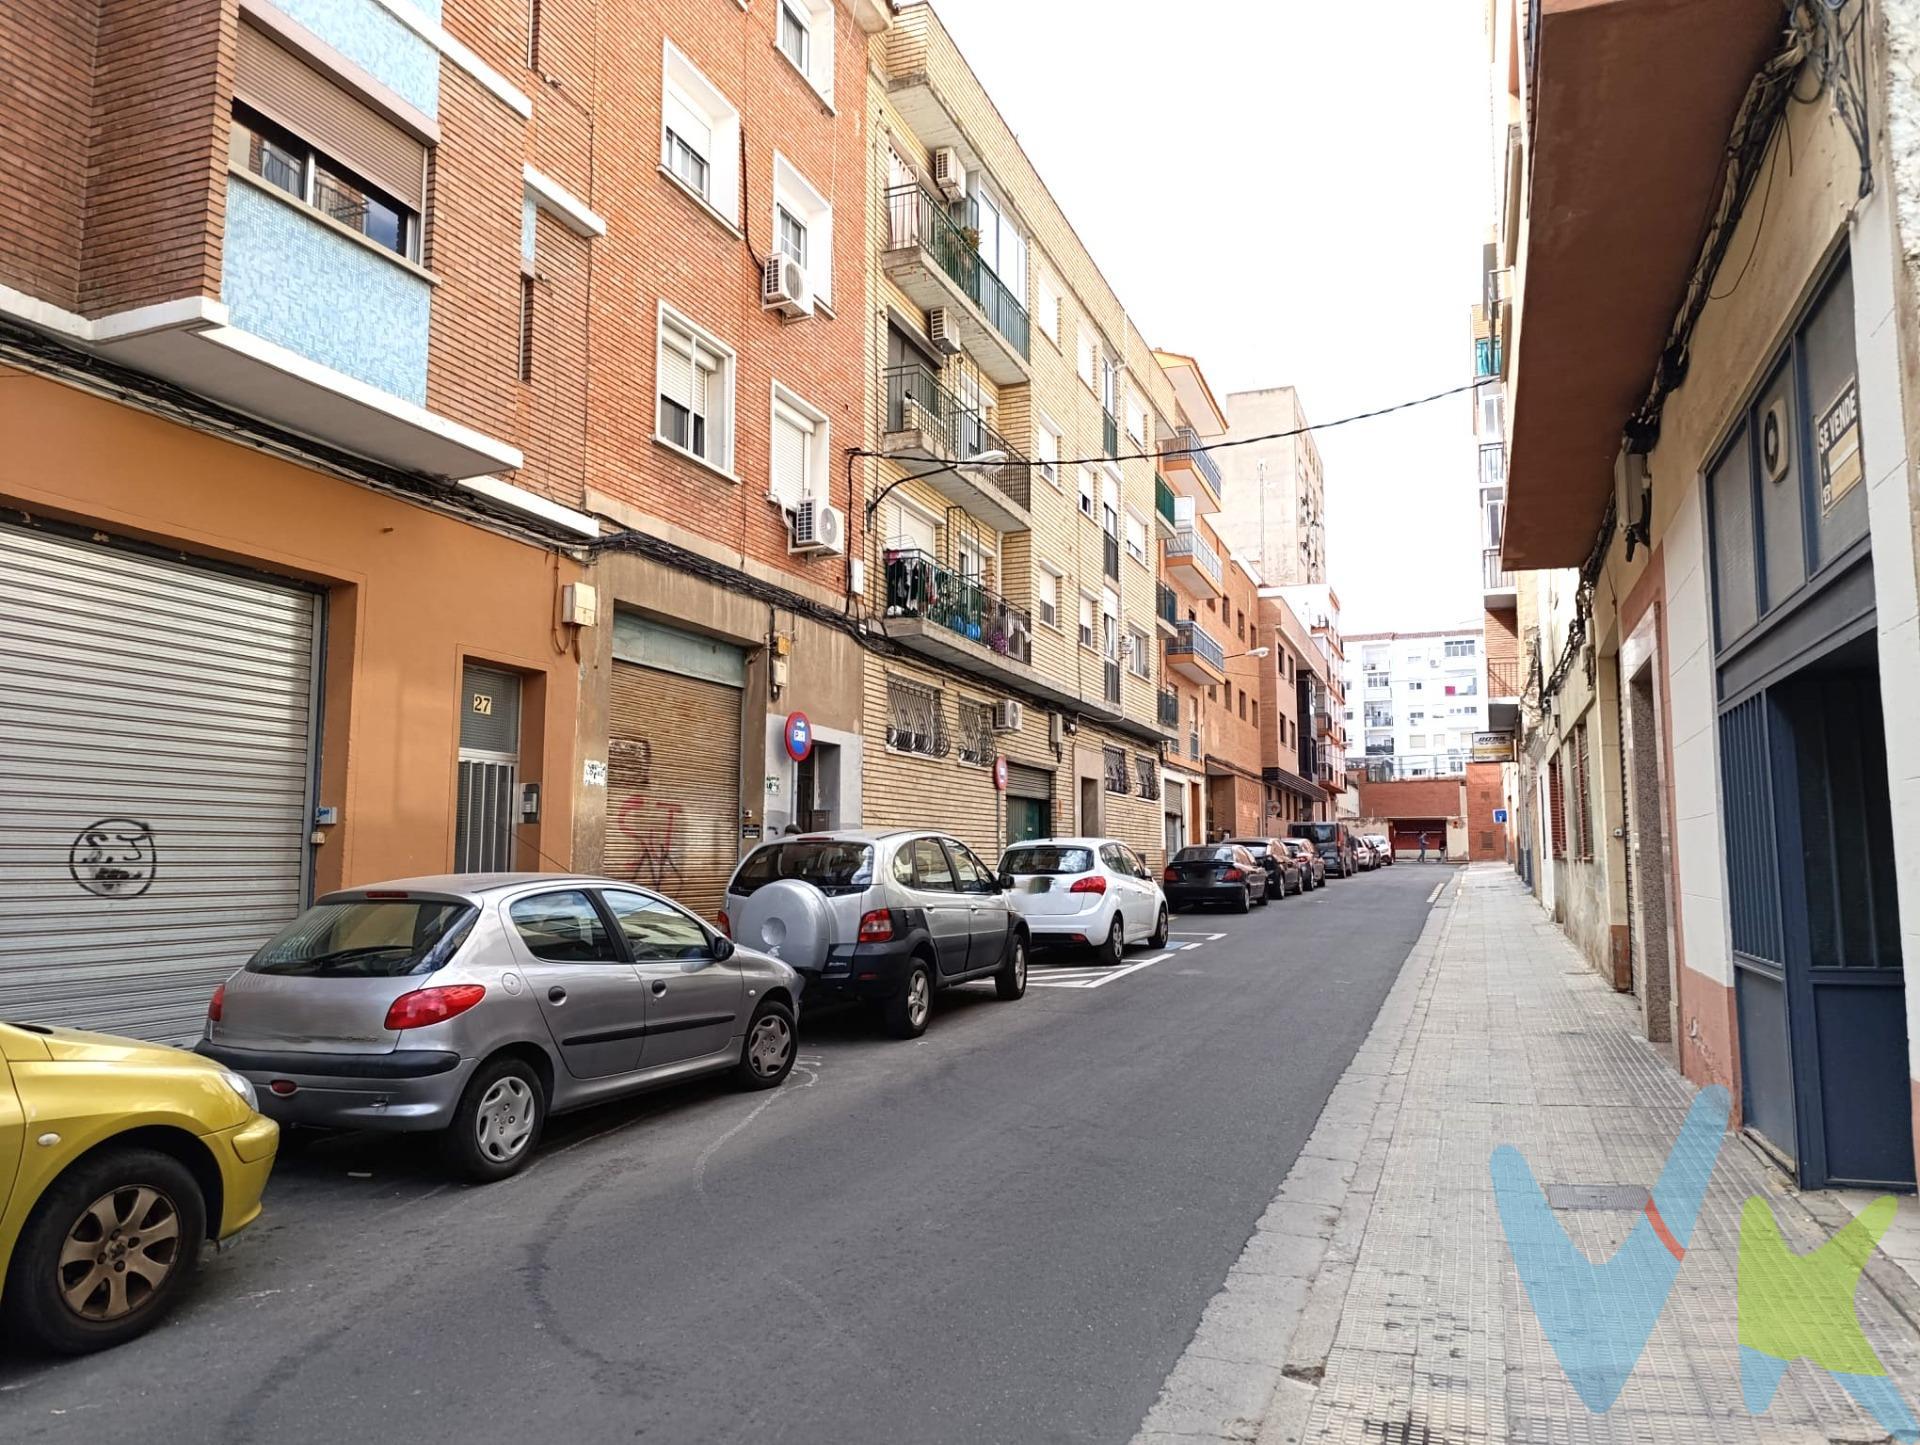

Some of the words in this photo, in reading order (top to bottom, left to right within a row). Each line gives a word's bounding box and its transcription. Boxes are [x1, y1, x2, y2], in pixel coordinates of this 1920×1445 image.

[1819, 421, 1830, 454] SE
[1829, 388, 1857, 442] VENDE
[474, 695, 490, 713] 27
